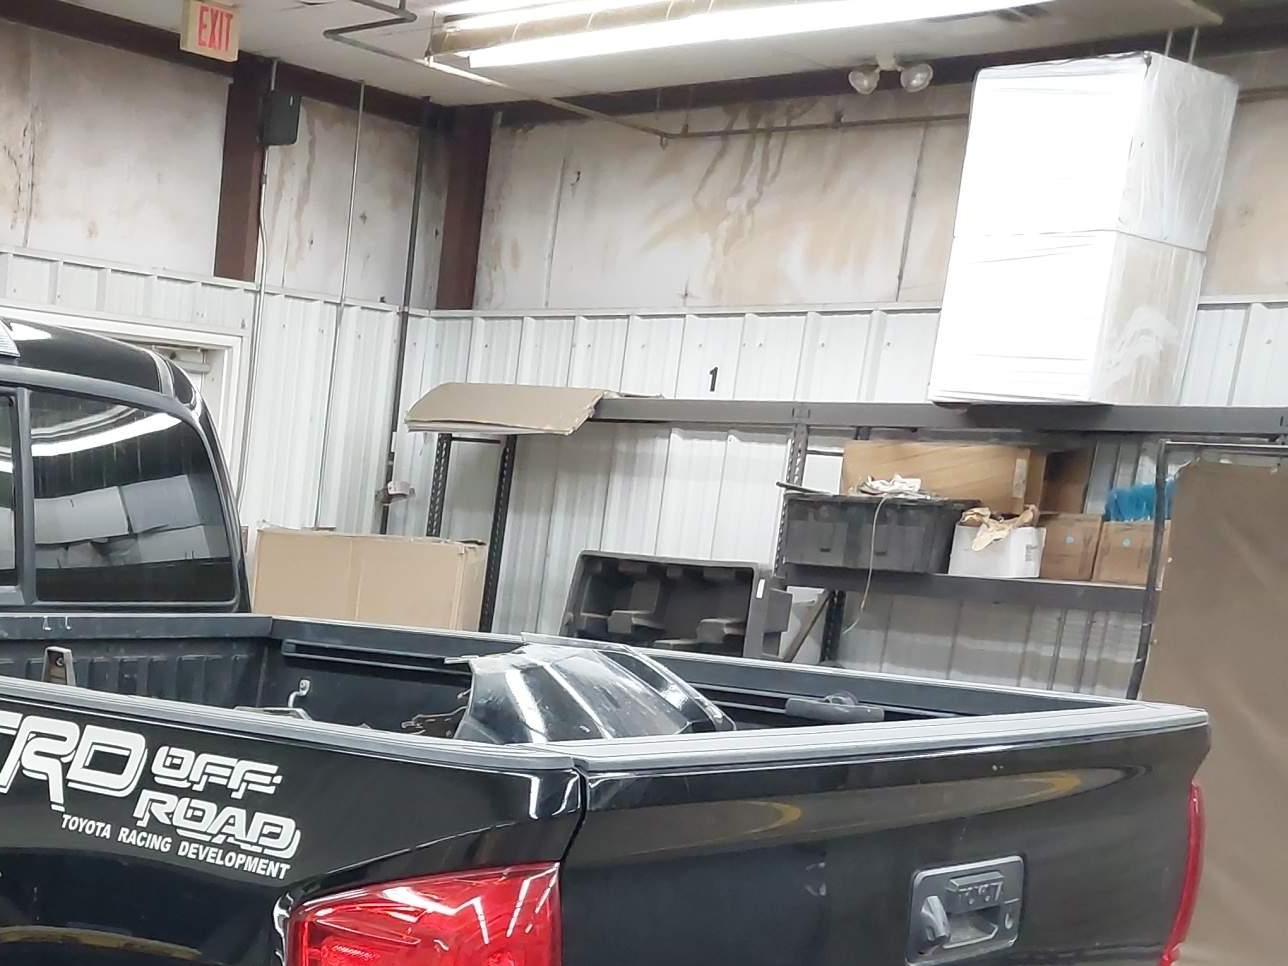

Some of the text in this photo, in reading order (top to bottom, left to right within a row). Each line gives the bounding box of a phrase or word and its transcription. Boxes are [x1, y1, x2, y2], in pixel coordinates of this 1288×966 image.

[198, 5, 233, 51] EXIT
[709, 366, 718, 392] 1
[151, 745, 283, 798] OFF
[61, 813, 291, 880] TOYOTA RACING DEVELOPMENT
[133, 789, 301, 859] ROAD
